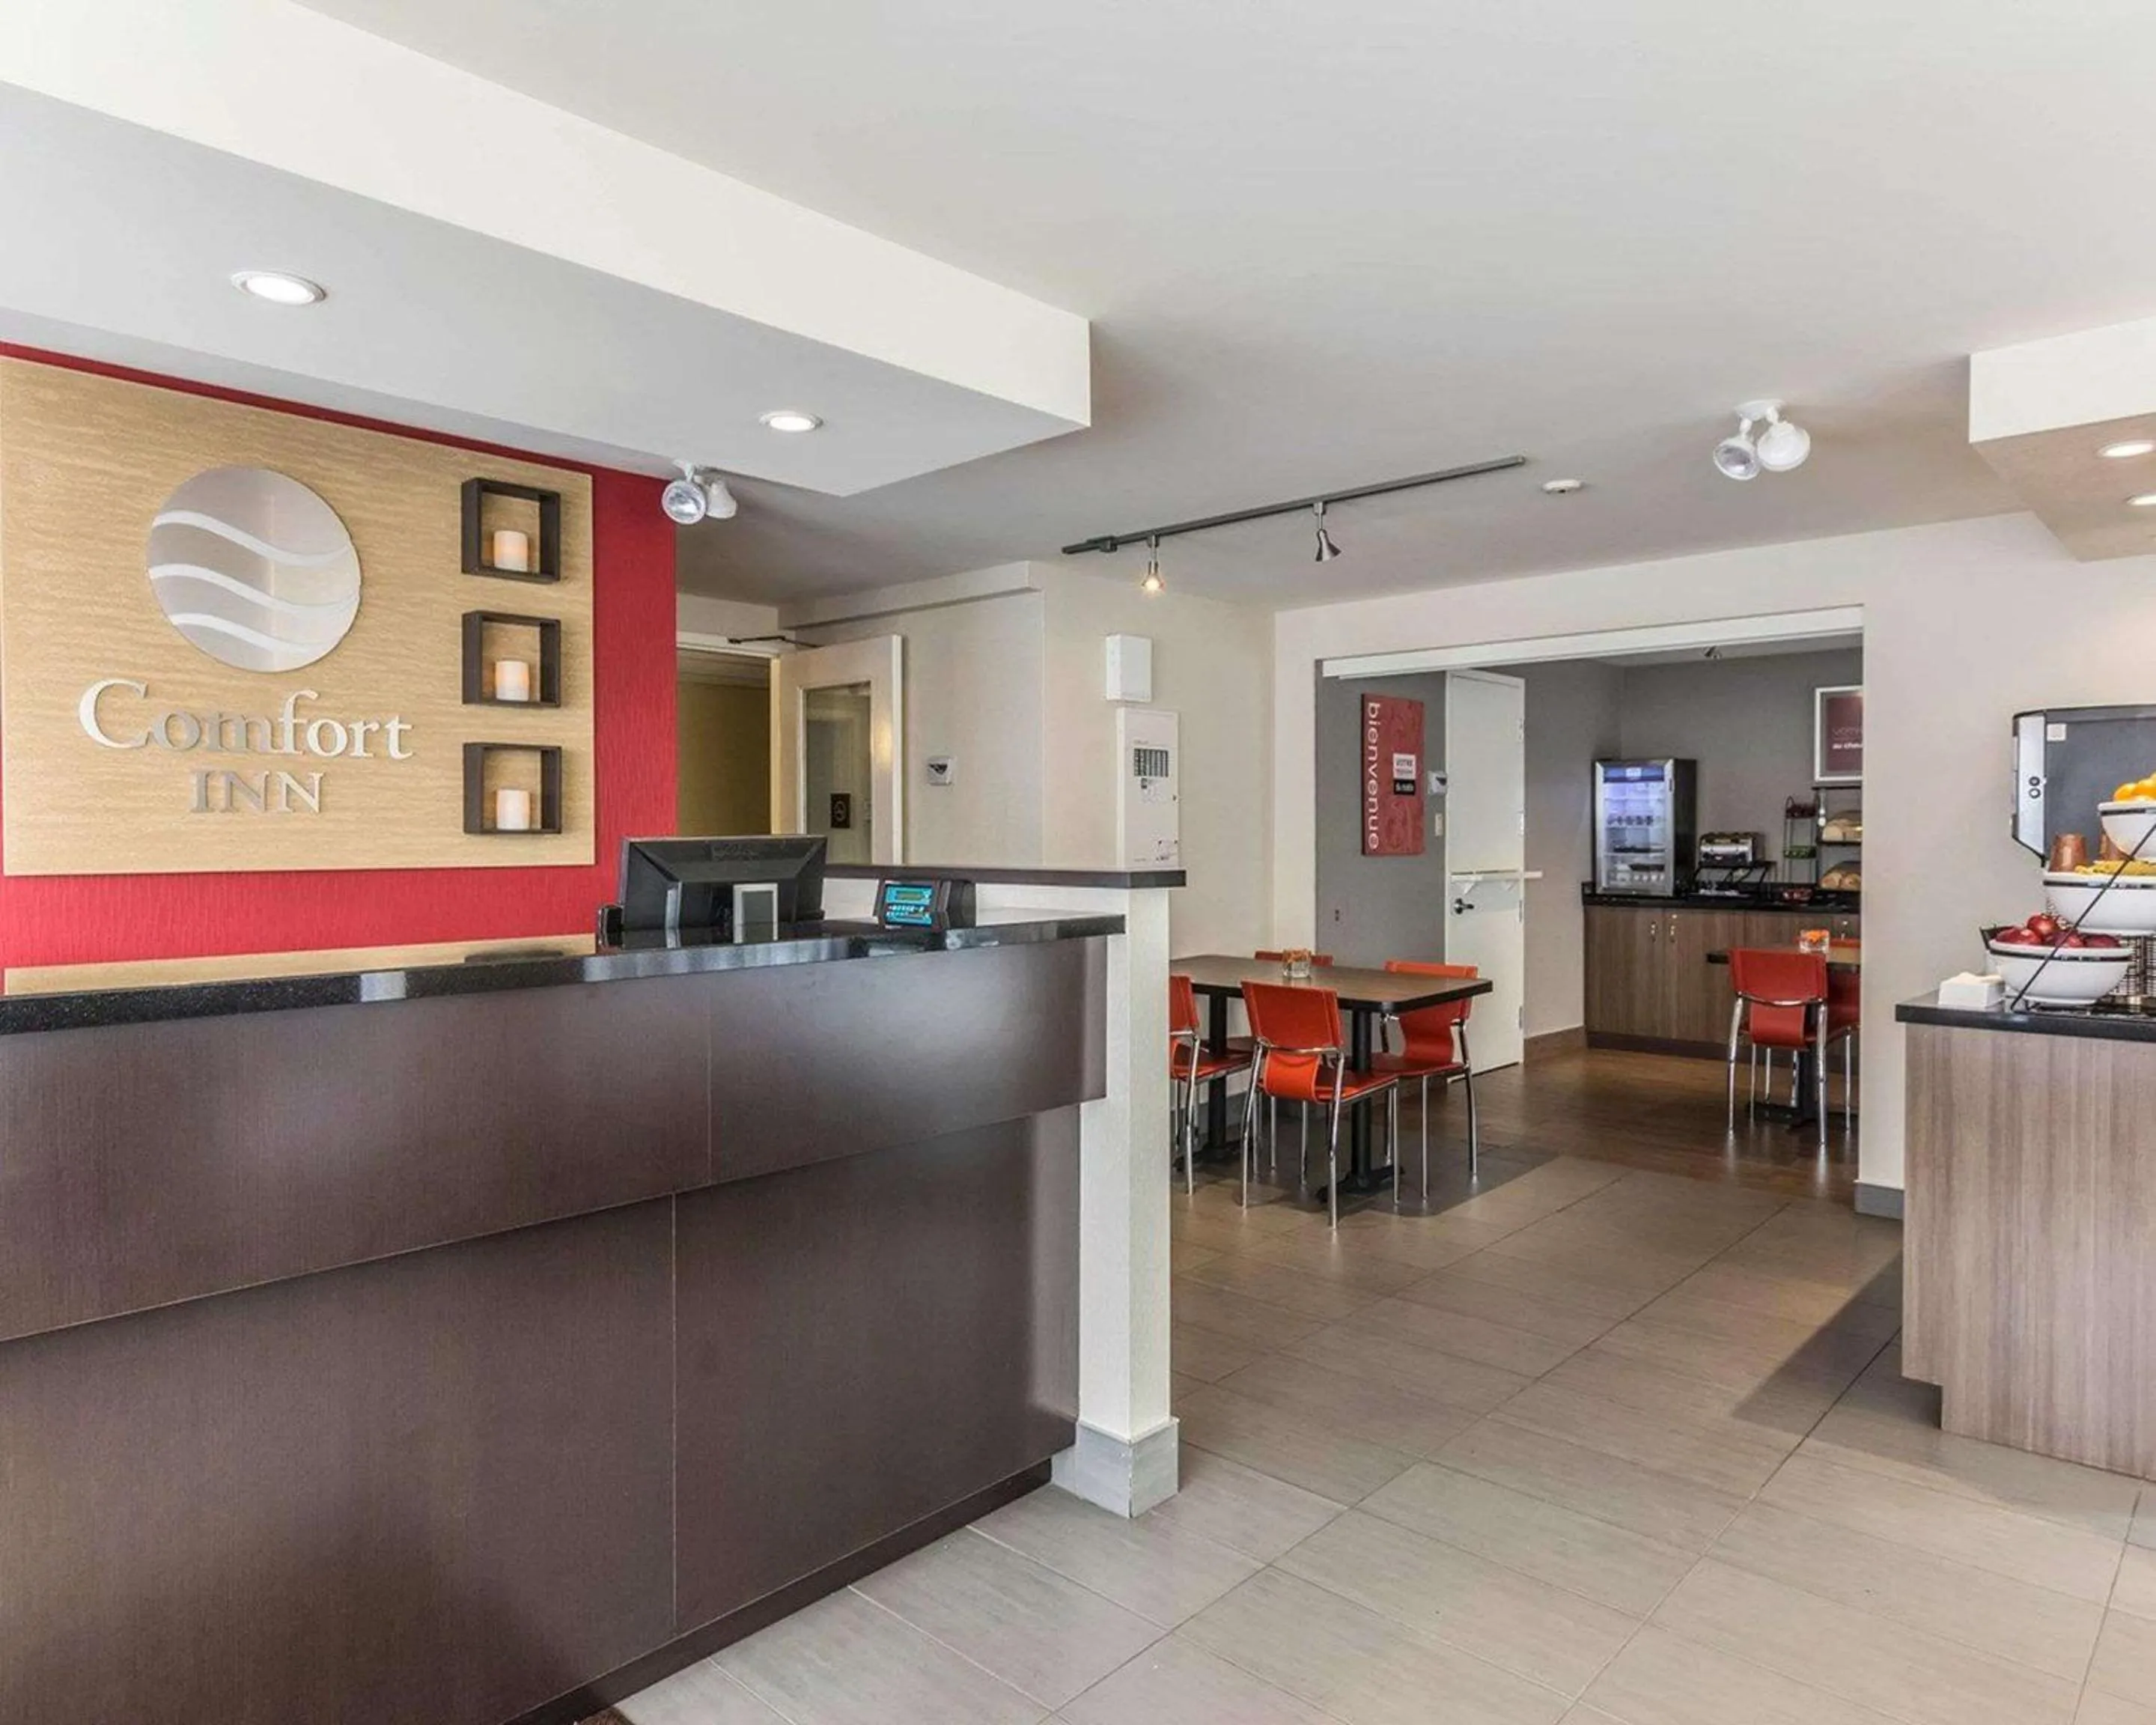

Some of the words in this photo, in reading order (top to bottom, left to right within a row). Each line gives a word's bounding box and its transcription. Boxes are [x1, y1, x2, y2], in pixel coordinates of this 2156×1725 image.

[79, 678, 414, 760] Comfort
[190, 770, 326, 814] INN
[1368, 702, 1381, 850] bienvenue
